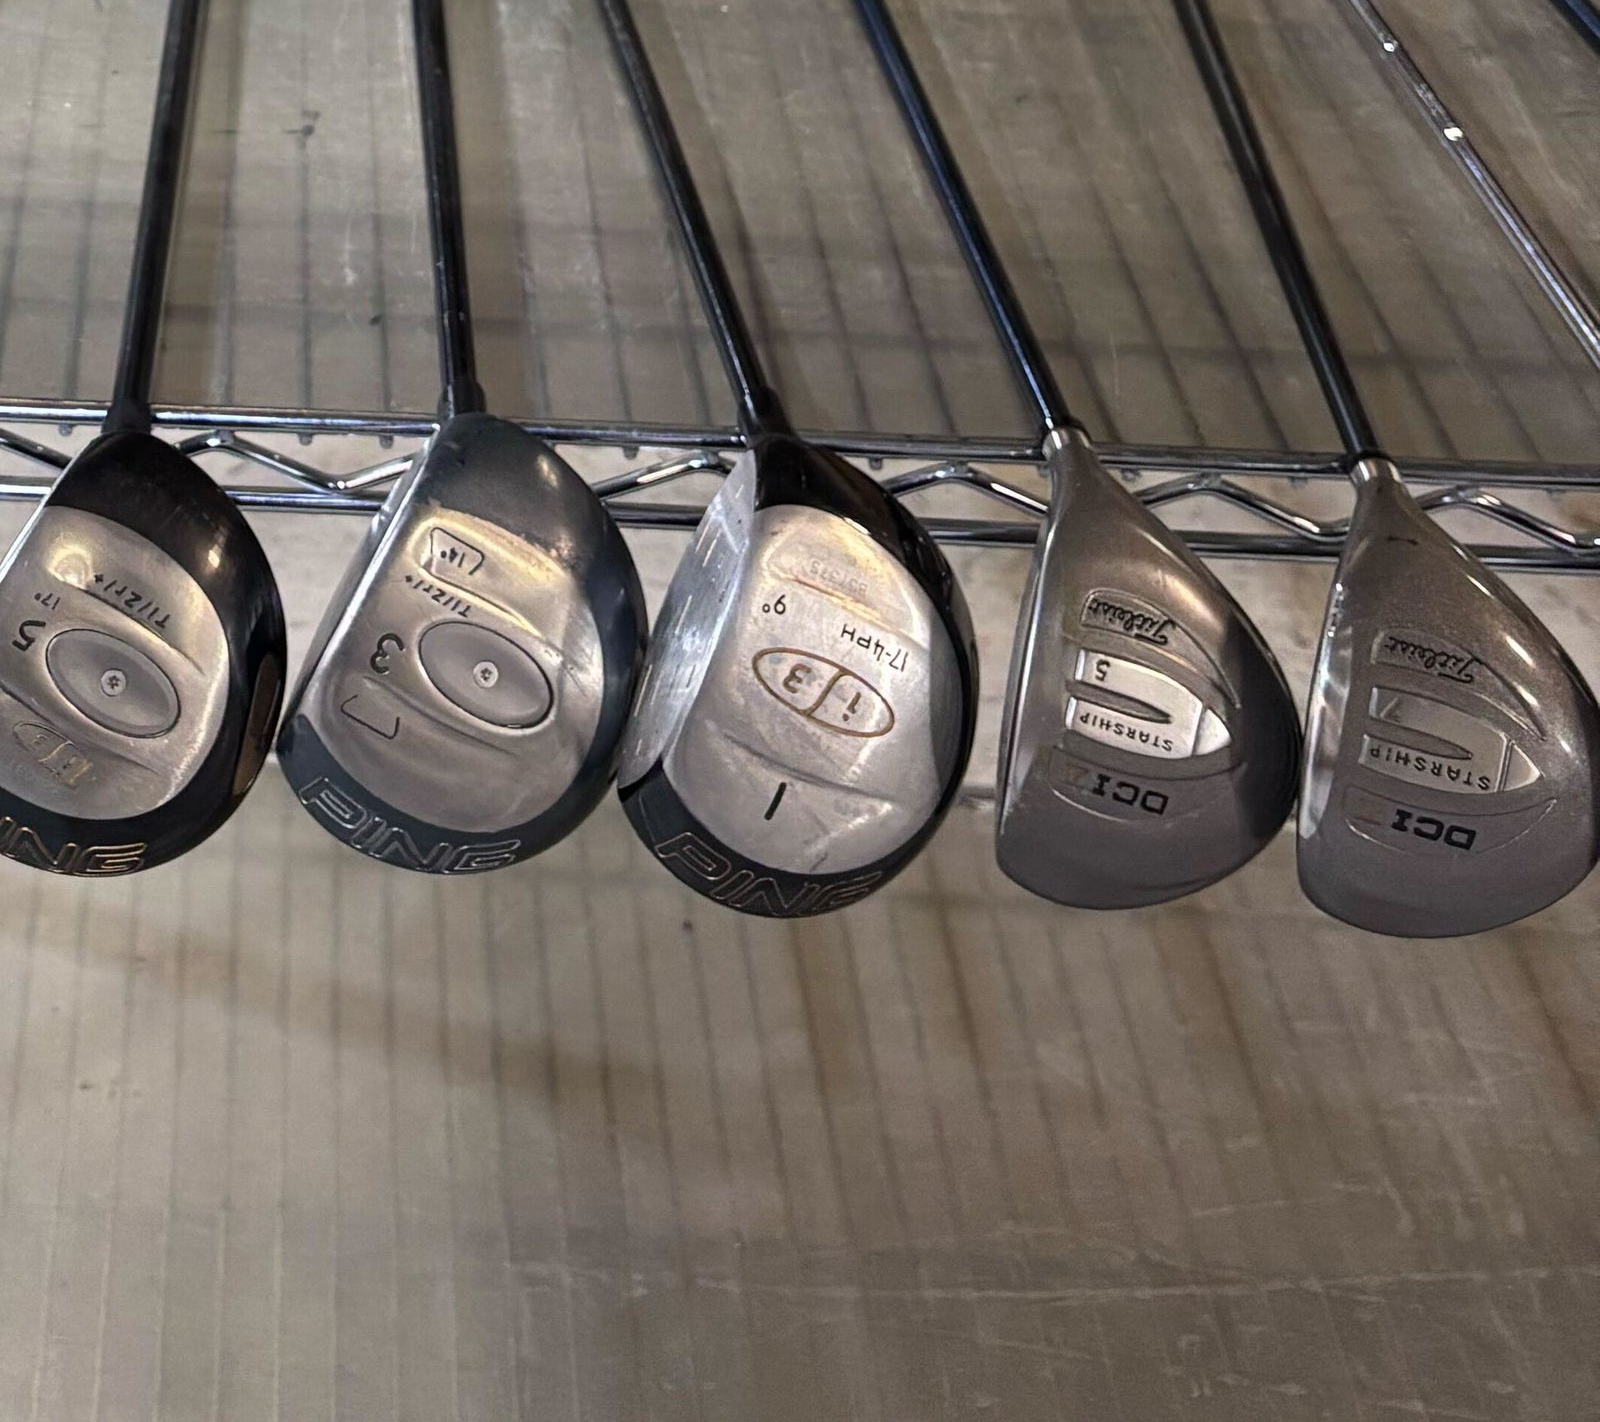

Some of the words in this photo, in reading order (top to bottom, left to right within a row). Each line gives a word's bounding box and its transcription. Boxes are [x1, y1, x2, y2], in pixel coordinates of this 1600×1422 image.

[760, 593, 787, 616] 9°
[1086, 597, 1176, 645] Titleist
[10, 617, 46, 652] 5
[367, 630, 407, 677] 3
[838, 622, 909, 673] 17-4PH
[1093, 658, 1110, 682] 5
[1382, 634, 1480, 684] Titleist
[1076, 710, 1172, 752] STARSHIP
[1367, 744, 1491, 791] STARSHIP
[1091, 772, 1169, 816] DCI
[302, 776, 521, 876] PING
[1389, 807, 1476, 851] DCI
[655, 831, 883, 917] PING
